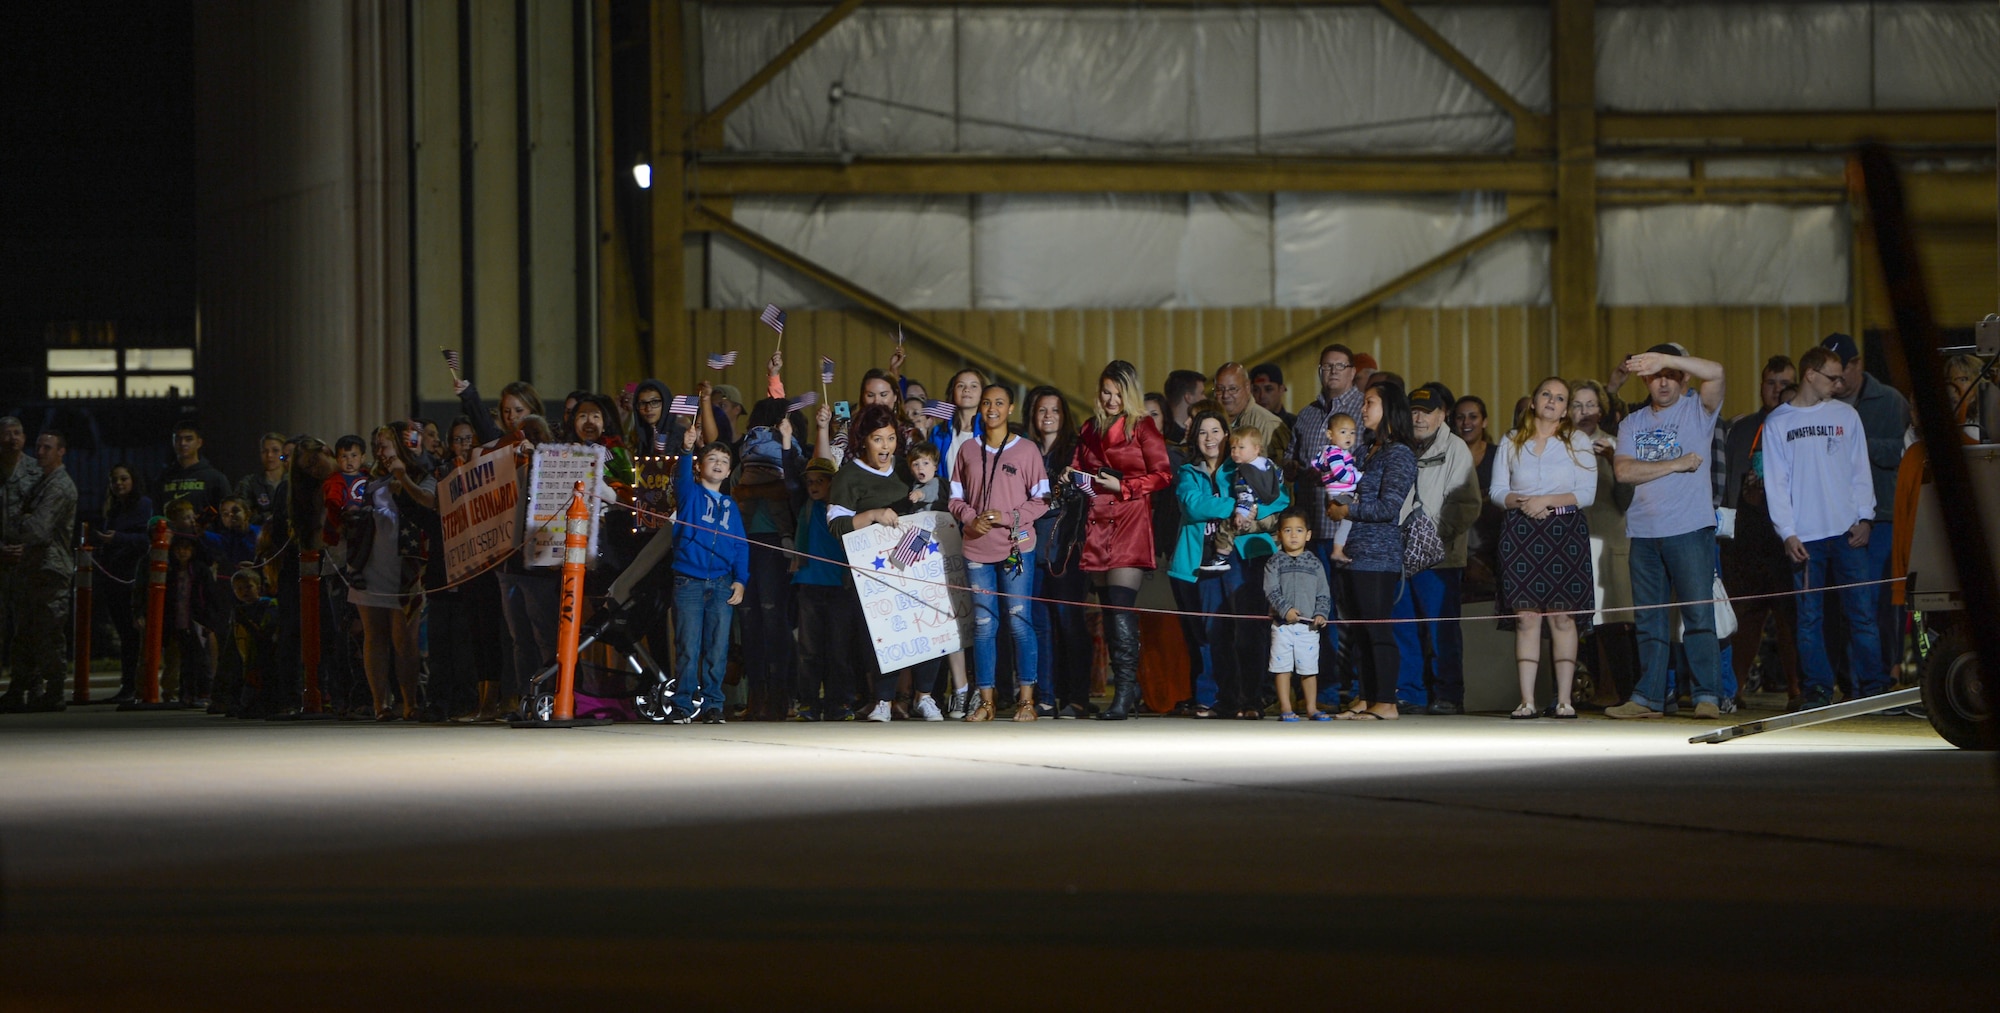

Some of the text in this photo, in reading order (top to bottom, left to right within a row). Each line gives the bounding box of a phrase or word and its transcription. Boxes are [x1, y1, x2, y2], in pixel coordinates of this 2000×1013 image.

[635, 462, 670, 491] Keep
[1002, 464, 1017, 475] PINK
[863, 575, 889, 597] AS
[912, 555, 964, 581] USED
[865, 598, 894, 619] TO
[877, 636, 931, 665] YOUR
